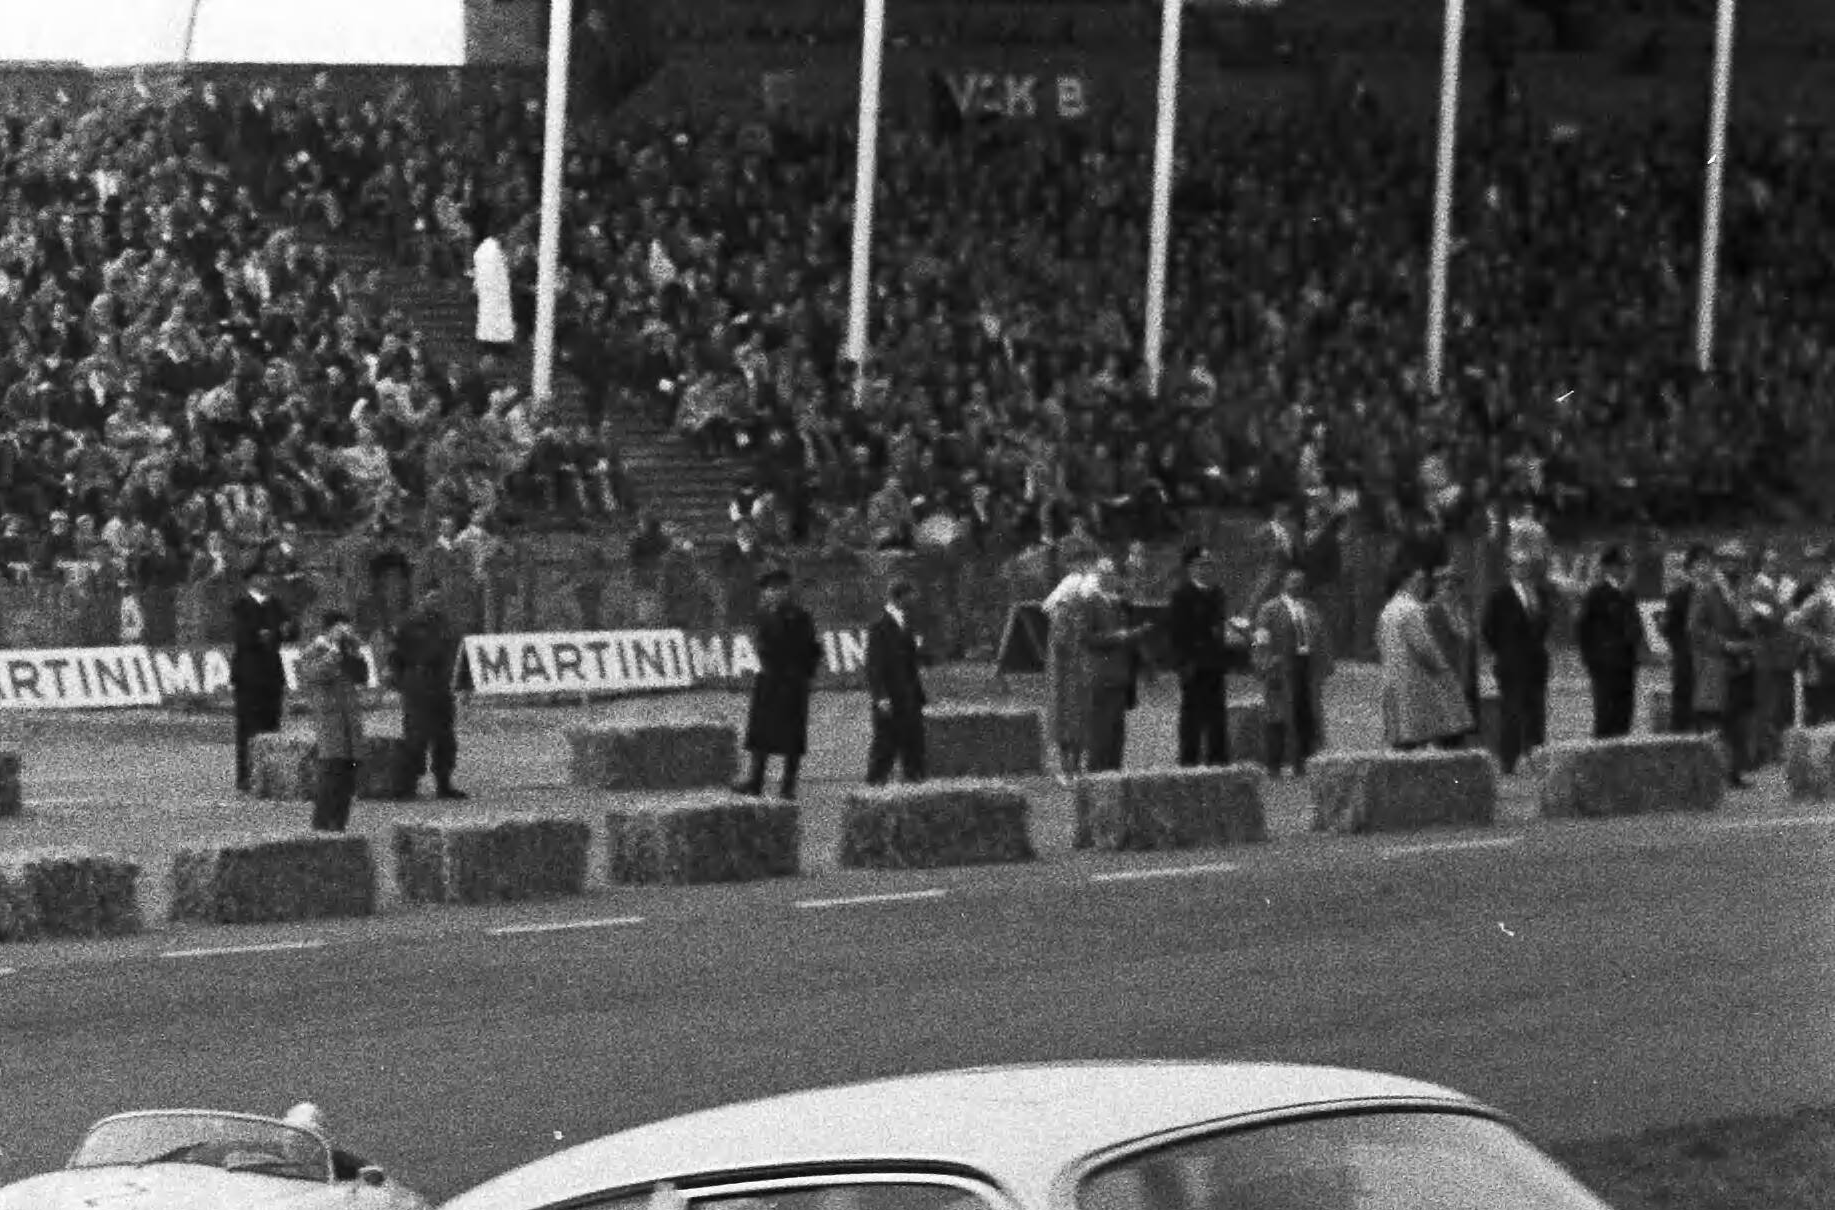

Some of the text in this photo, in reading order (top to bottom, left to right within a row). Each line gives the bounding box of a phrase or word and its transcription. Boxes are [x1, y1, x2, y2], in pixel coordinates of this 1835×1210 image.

[1055, 76, 1087, 118] B
[154, 645, 379, 695] MATI
[474, 640, 690, 686] MARTINI
[689, 629, 869, 678] MAIN
